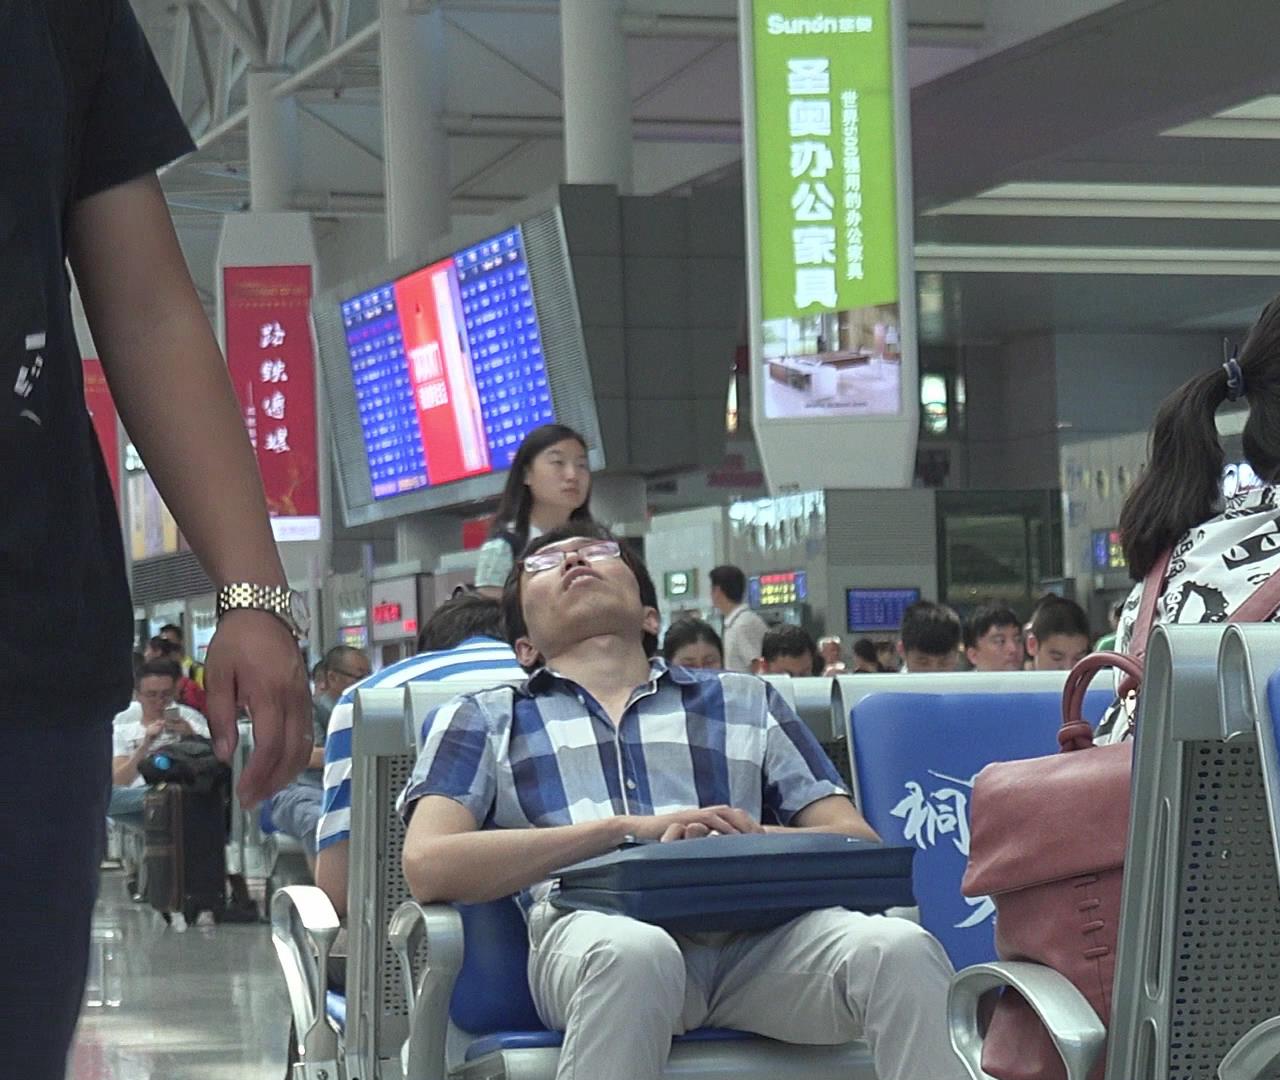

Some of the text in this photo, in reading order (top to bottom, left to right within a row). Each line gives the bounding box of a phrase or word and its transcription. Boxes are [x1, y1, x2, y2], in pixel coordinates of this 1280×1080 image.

[787, 57, 838, 309] 圣奥办公家具
